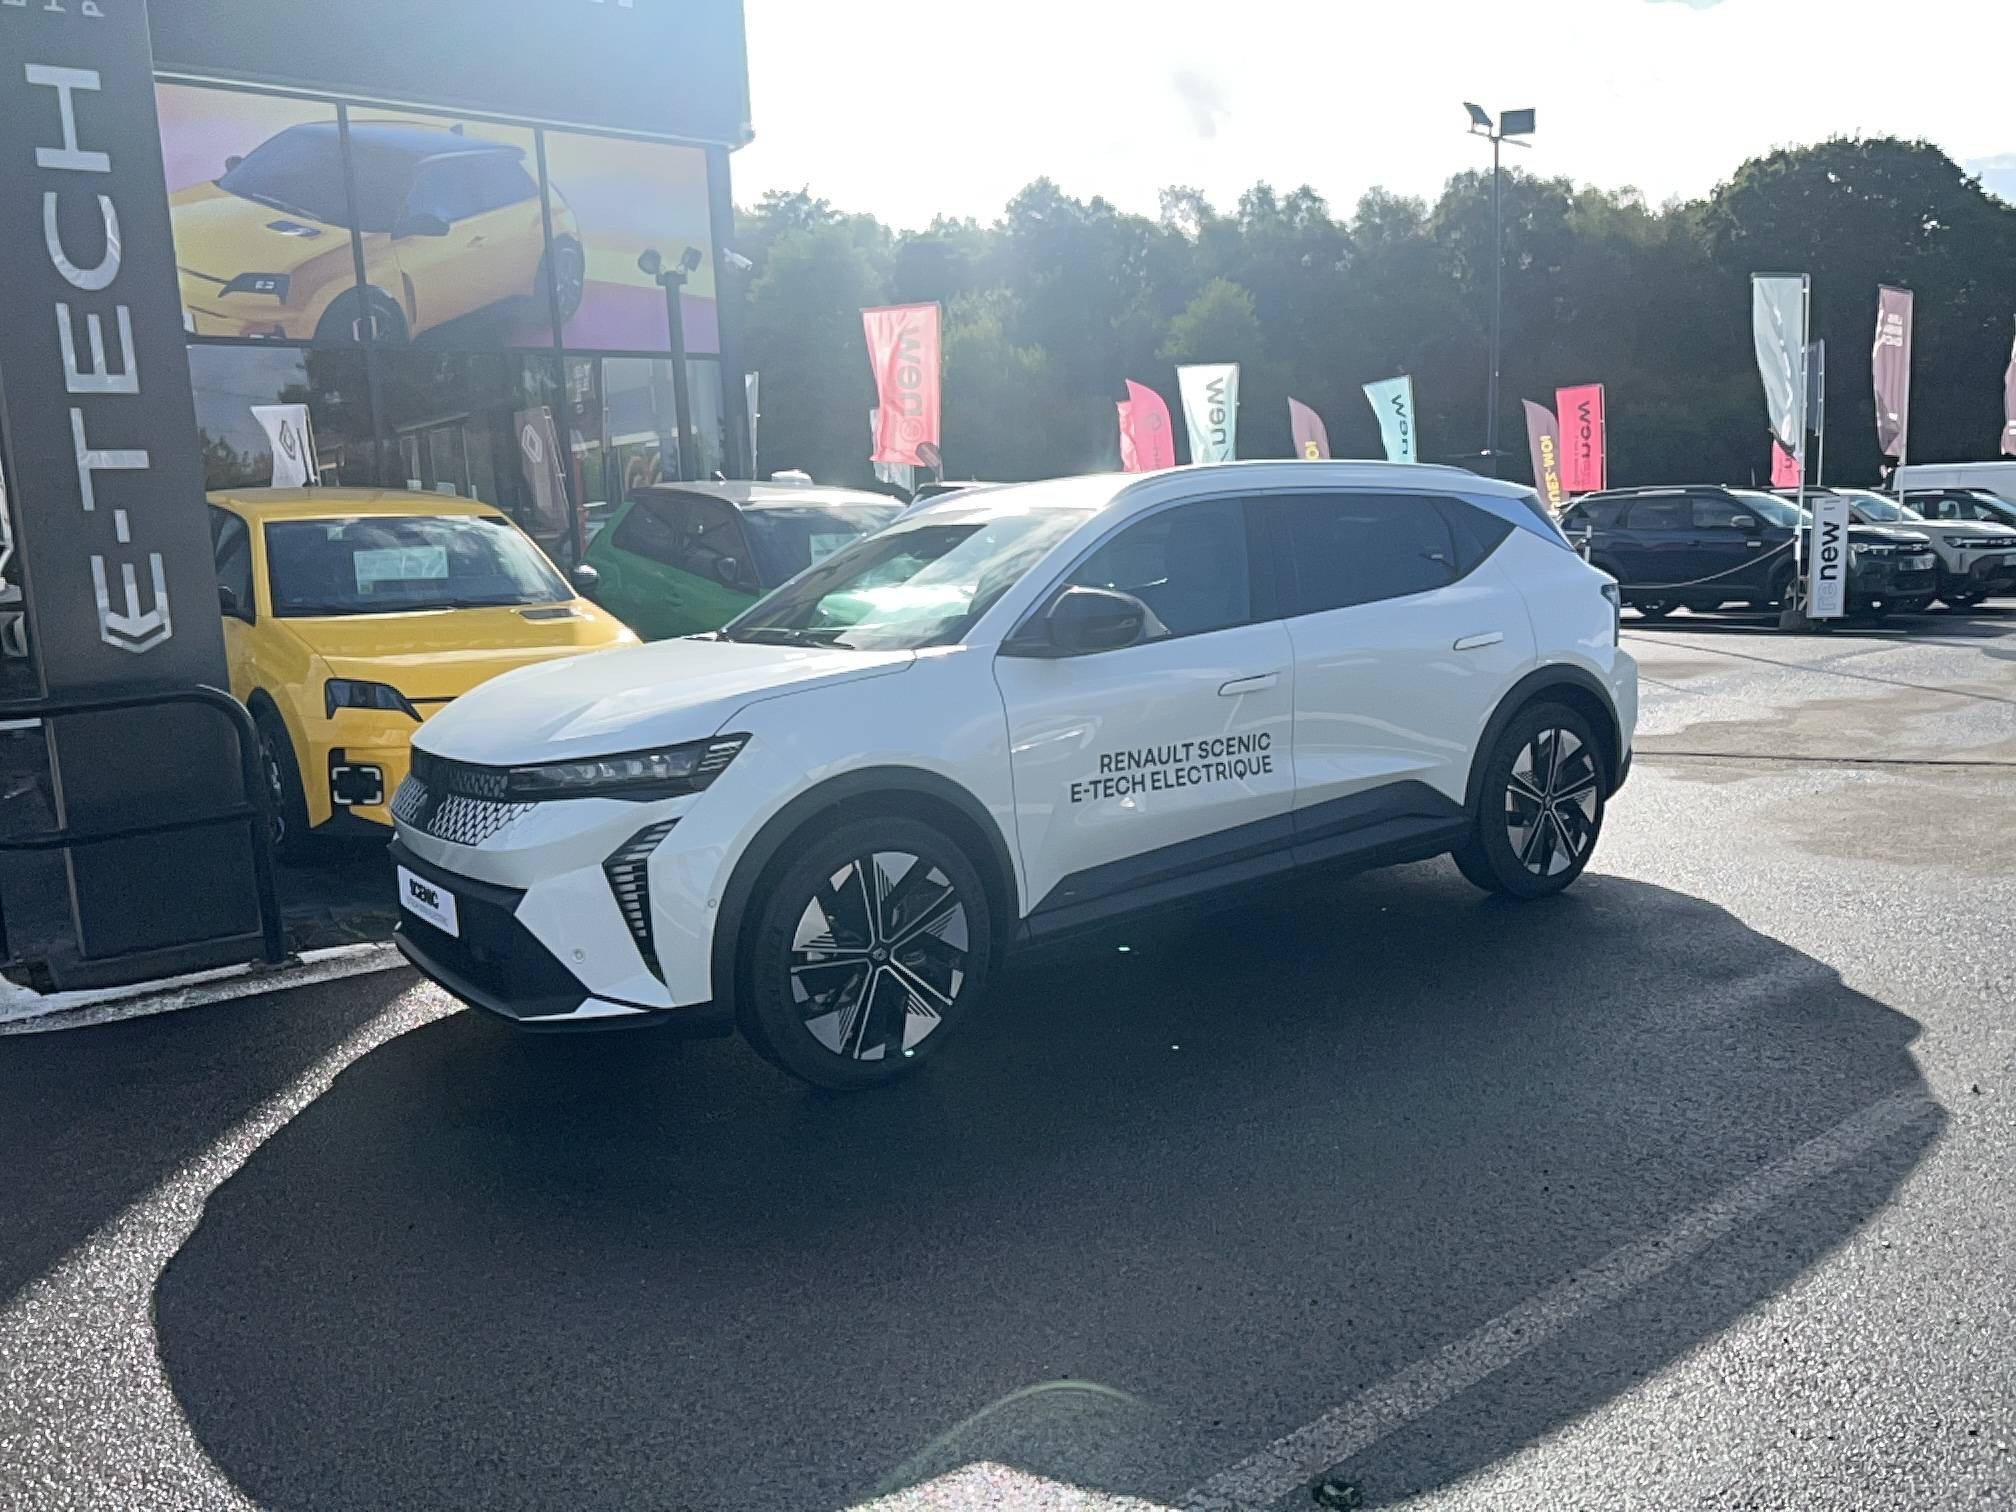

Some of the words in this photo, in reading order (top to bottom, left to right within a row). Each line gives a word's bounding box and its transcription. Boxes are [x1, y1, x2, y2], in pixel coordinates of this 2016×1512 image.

[1100, 742, 1194, 774] RENAULT
[1198, 732, 1271, 760] SCENIC
[1071, 774, 1146, 803] E-TECH
[1151, 755, 1273, 792] ELECTRIQUE
